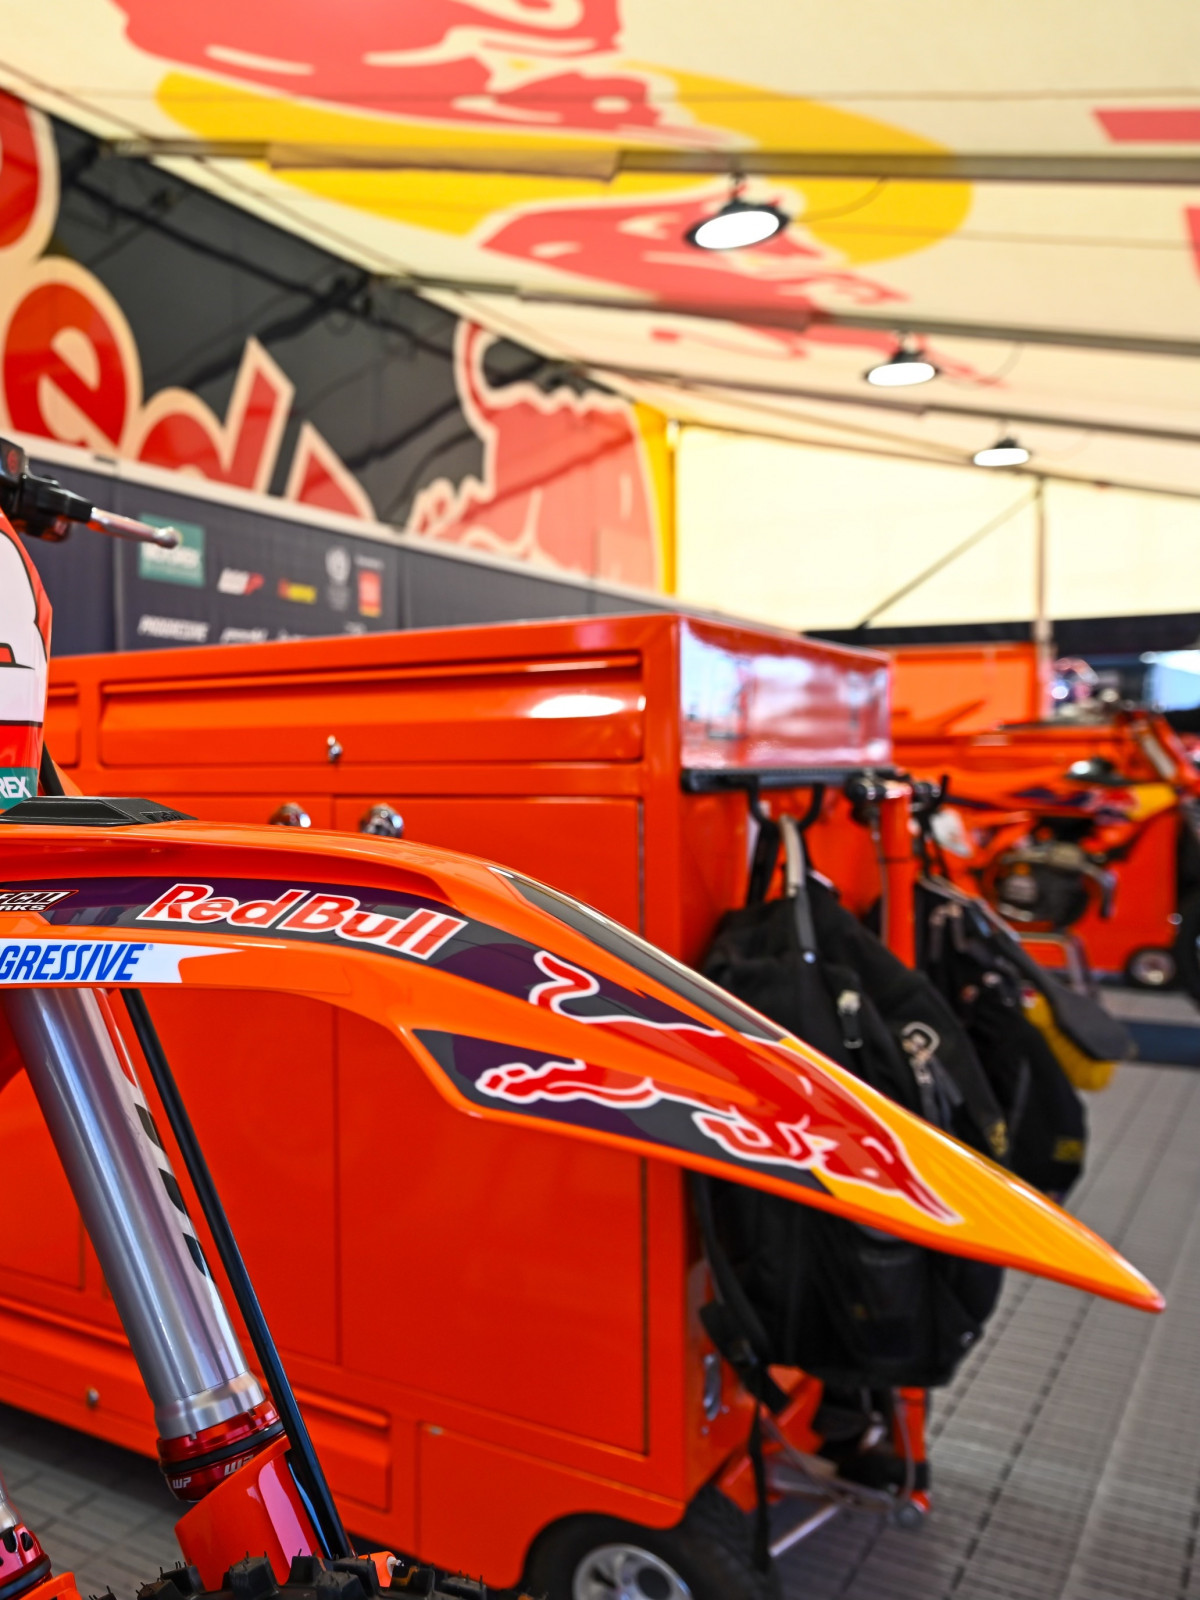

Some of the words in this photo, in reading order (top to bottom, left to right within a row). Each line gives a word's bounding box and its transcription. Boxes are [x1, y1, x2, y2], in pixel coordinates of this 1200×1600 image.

[136, 883, 297, 930] Red
[277, 893, 468, 960] Bull
[172, 1476, 192, 1489] WP
